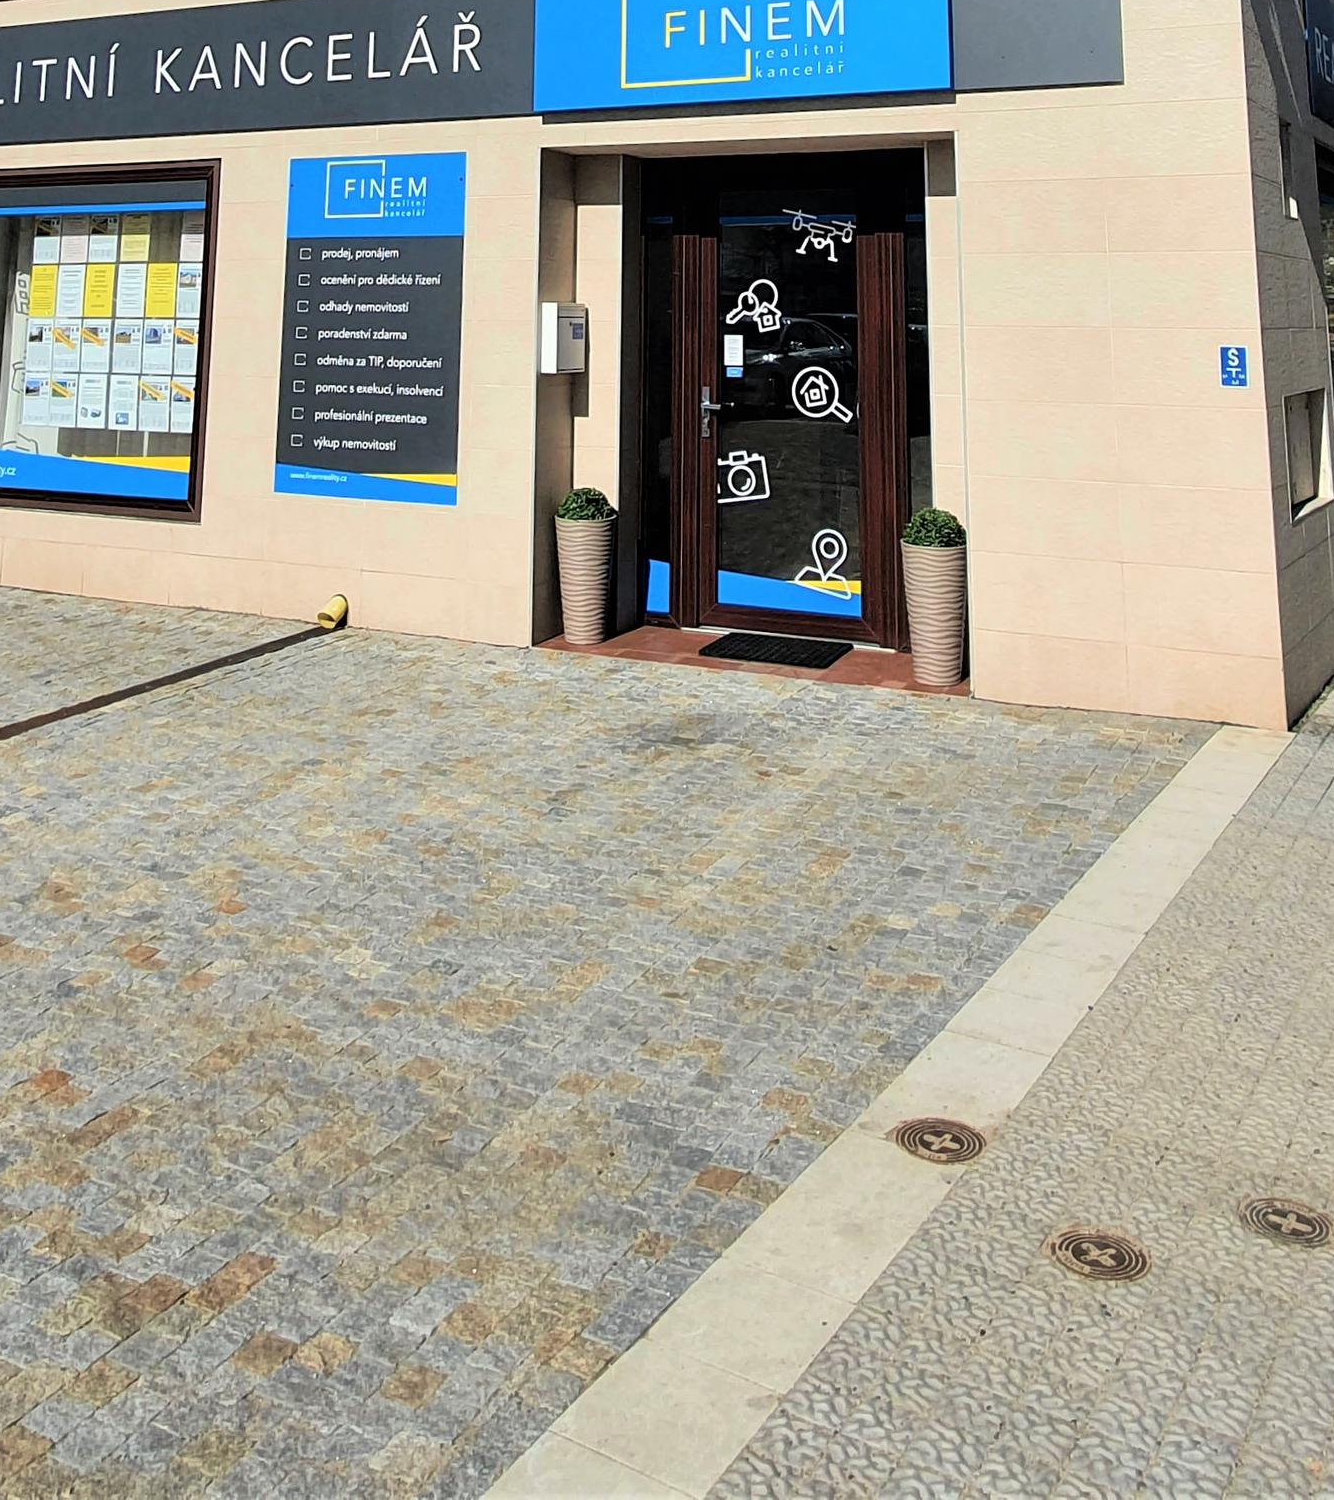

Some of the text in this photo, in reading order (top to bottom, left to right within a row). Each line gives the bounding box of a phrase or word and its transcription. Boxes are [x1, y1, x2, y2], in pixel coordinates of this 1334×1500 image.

[154, 11, 483, 94] KANCELÁŘ
[755, 61, 845, 79] kancelář
[344, 176, 427, 199] FINEM
[321, 247, 400, 261] prodej, pronájem
[320, 274, 442, 287] ocenění pro dědické řízení
[319, 300, 410, 314] odhady nemovitostí
[318, 327, 408, 341] poradenství zdarma
[317, 354, 443, 371] odměna za TIP, doporučení
[315, 383, 348, 395] pomoc
[356, 383, 394, 396] exekucí,
[396, 384, 444, 397] insolvencí
[315, 408, 428, 425] profesionální prezentace
[313, 436, 397, 451] výkup nemovitostí
